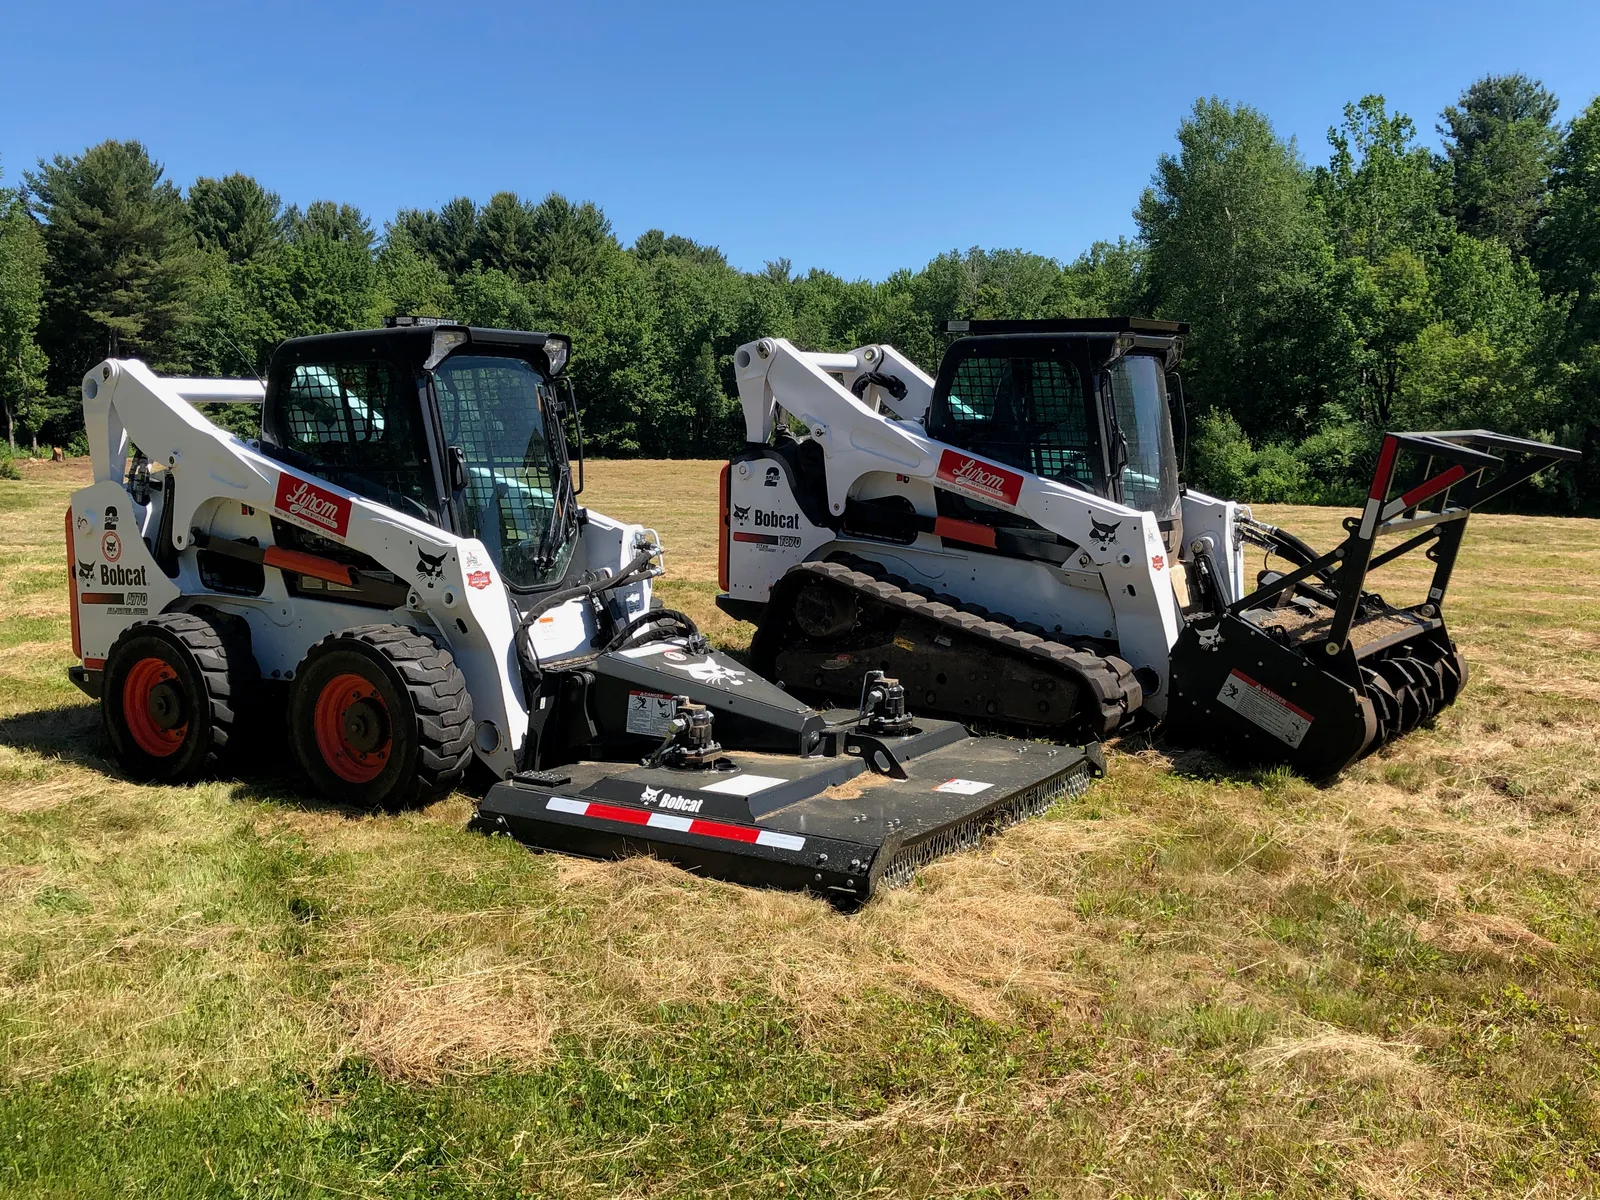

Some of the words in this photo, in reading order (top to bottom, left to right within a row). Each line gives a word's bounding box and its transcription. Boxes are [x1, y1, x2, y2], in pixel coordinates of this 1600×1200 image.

[764, 467, 780, 487] 2
[104, 506, 118, 530] 2
[754, 509, 799, 530] Bobcat
[779, 535, 801, 548] T870
[100, 564, 147, 586] Bobcat
[126, 592, 148, 606] A770
[1262, 687, 1287, 705] DANGER
[659, 793, 703, 813] Bobcat
